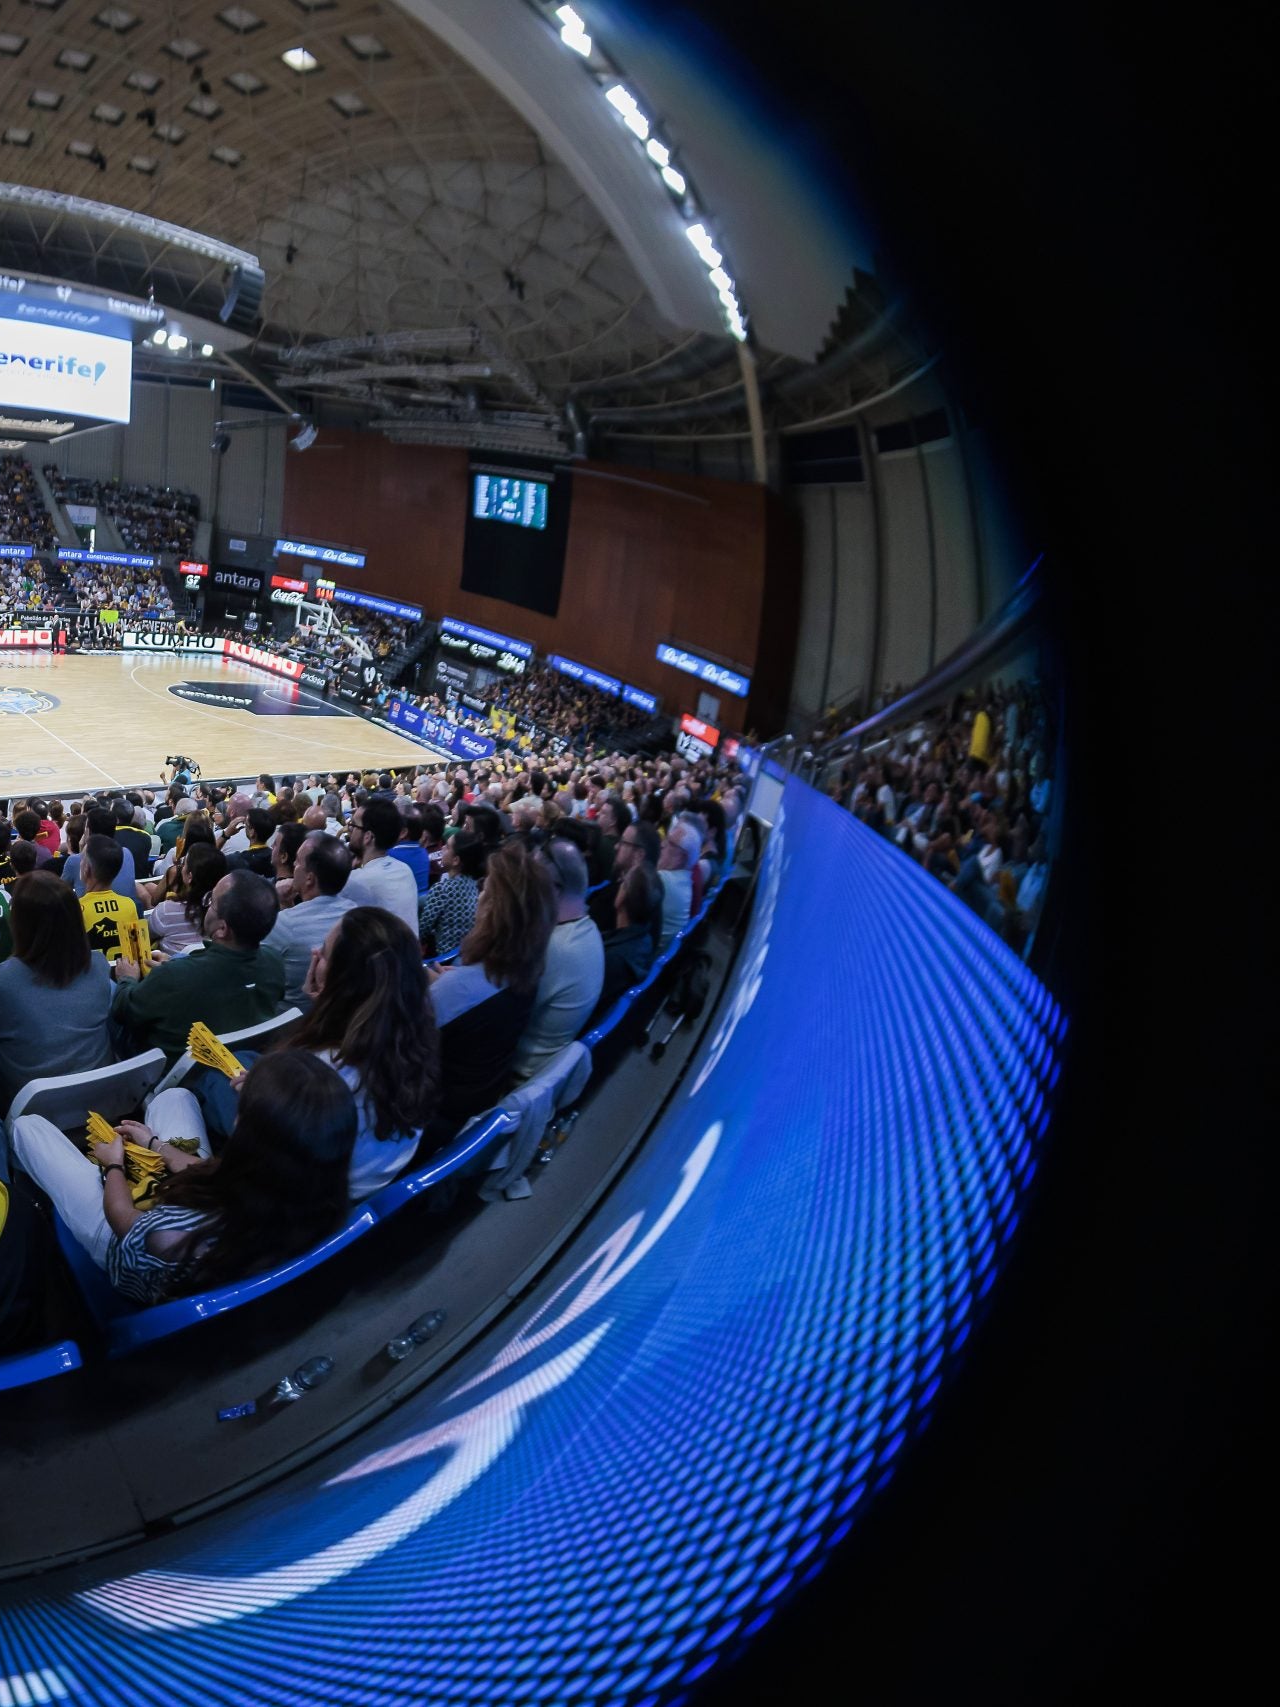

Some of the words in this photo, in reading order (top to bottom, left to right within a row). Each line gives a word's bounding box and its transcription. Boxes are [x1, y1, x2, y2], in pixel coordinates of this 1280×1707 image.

[0, 547, 26, 556] antara
[58, 548, 82, 560] antara
[86, 552, 128, 564] construcciones
[131, 556, 154, 568] antara
[214, 571, 261, 589] antara
[335, 590, 357, 601] antara
[400, 606, 421, 620] antara
[443, 620, 465, 632] antara
[228, 639, 298, 676] KUMHO
[94, 900, 119, 913] GIO
[103, 929, 119, 938] DIS
